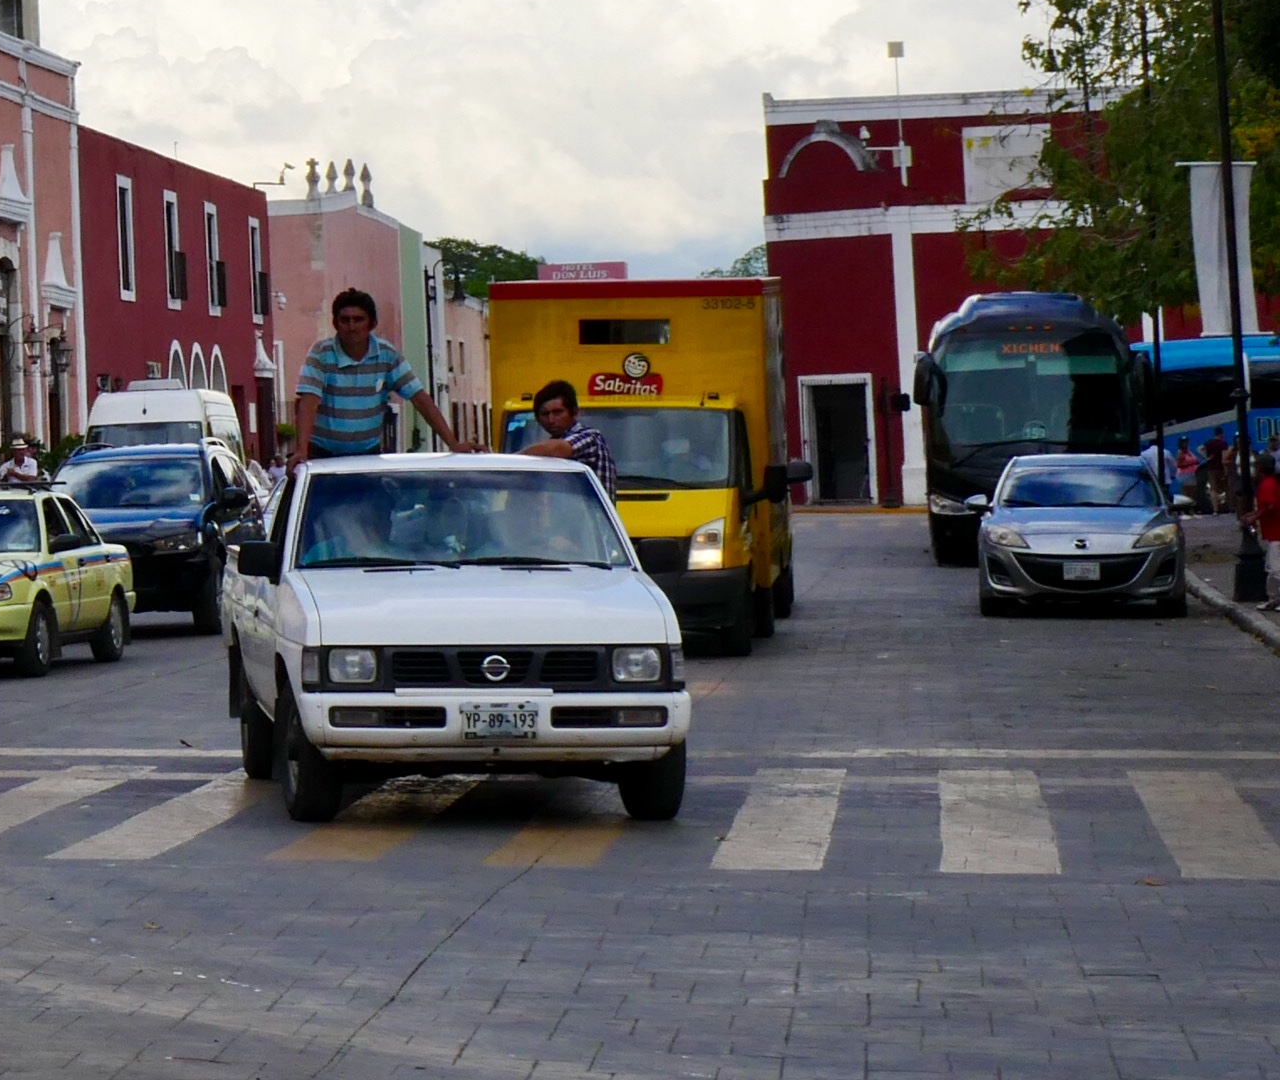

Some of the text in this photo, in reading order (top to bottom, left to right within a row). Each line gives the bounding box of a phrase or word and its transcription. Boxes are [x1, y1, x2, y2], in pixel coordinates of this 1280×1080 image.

[552, 270, 608, 280] DON LUIS
[702, 298, 756, 310] 33102-5
[593, 375, 658, 396] Sabritas
[465, 712, 536, 729] YP-89-193
